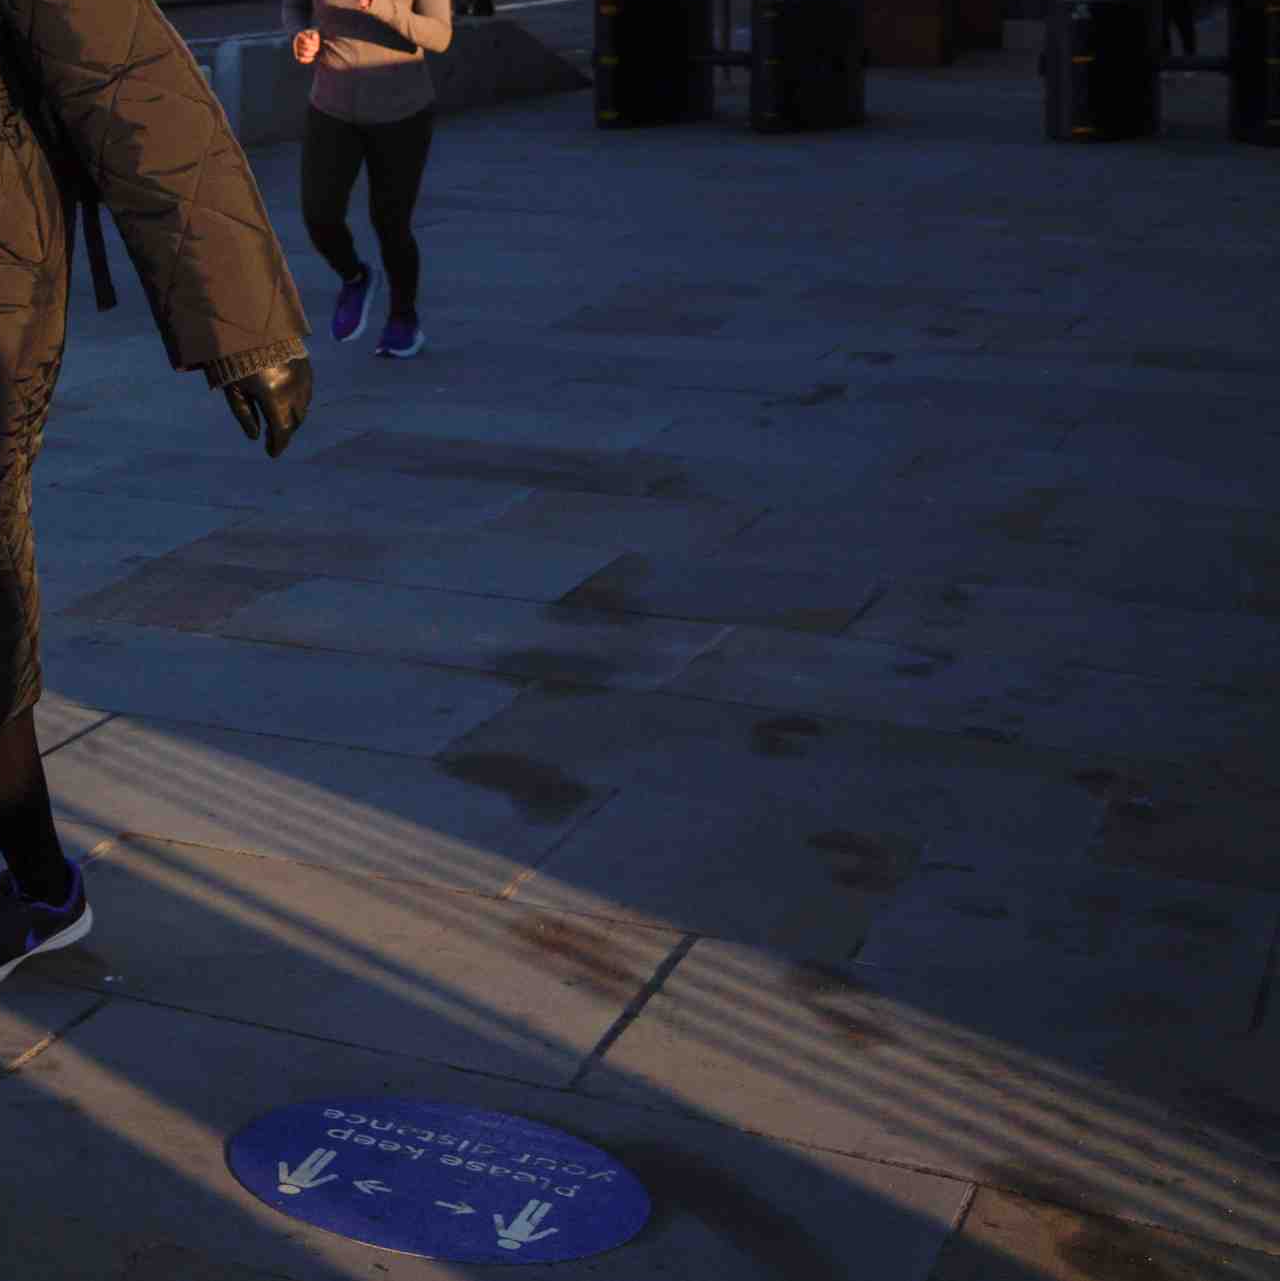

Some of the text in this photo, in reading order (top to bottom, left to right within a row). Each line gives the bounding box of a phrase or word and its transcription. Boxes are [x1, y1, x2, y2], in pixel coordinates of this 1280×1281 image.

[326, 1127, 580, 1198] Please keep
[510, 1153, 618, 1184] your
